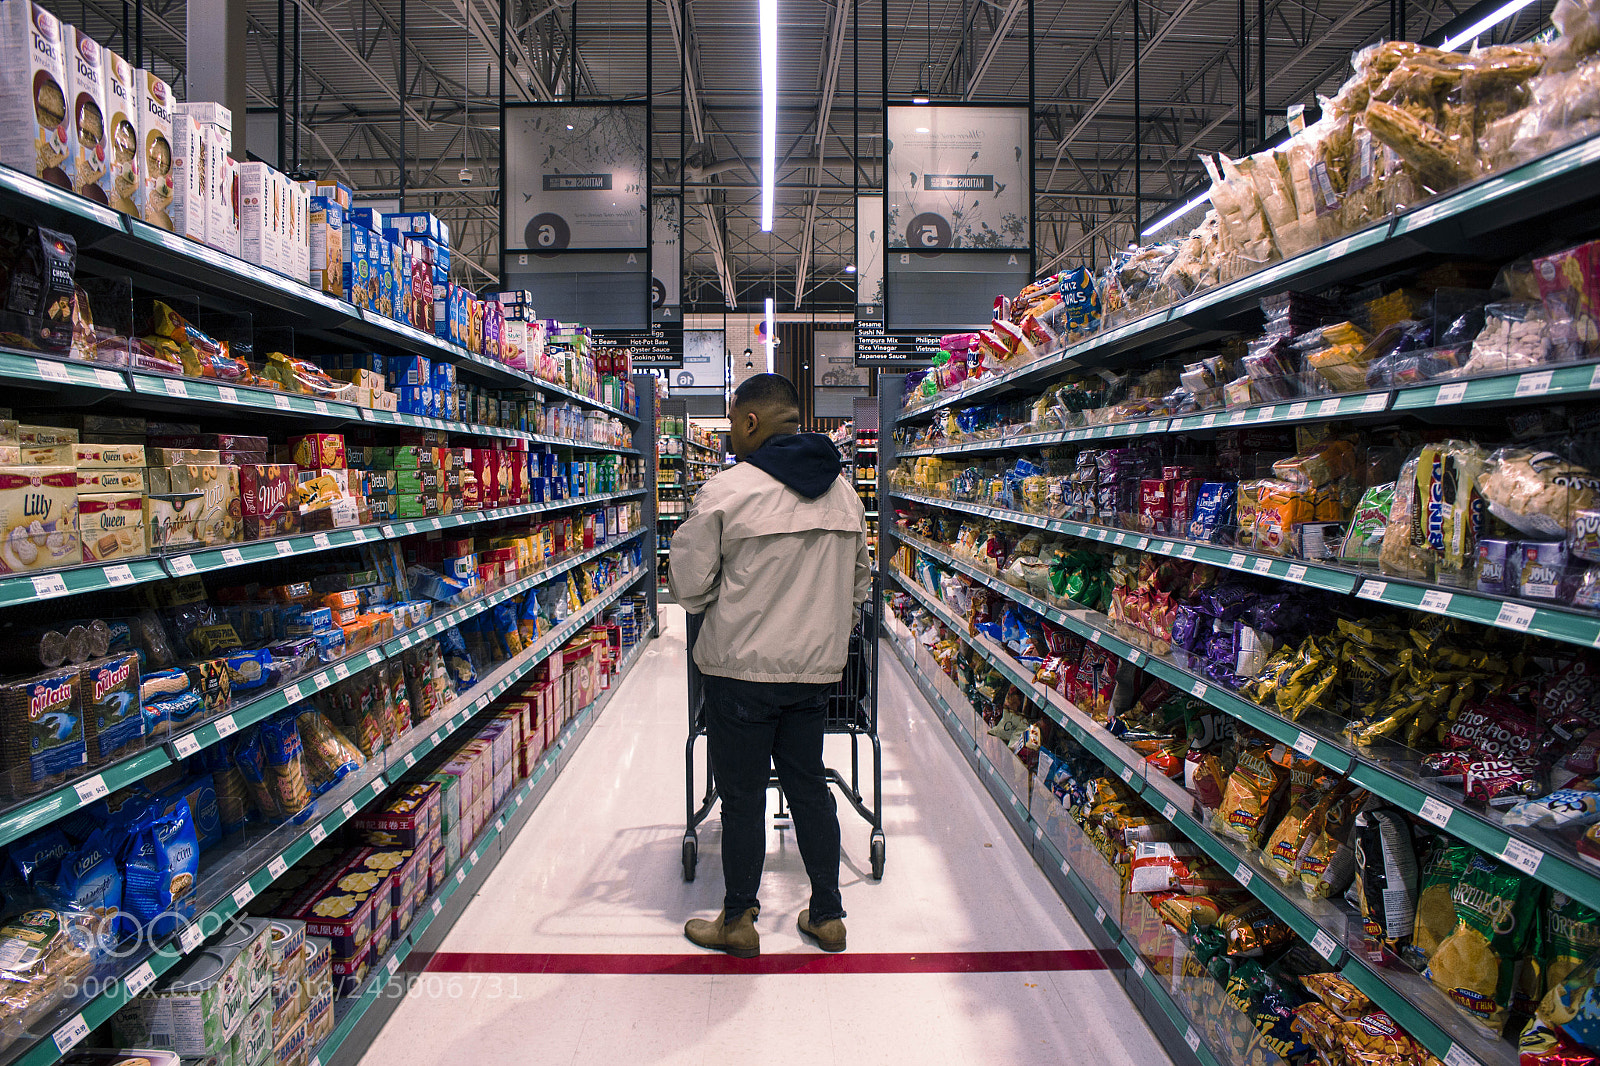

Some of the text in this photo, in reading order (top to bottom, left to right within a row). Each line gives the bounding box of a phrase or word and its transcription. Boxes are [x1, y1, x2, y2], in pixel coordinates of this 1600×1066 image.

[858, 328, 875, 336] Sushi
[858, 337, 886, 345] Tempura
[915, 337, 942, 345] Philippin
[872, 344, 898, 352] Vinegar
[630, 346, 651, 354] Oyster
[858, 353, 888, 361] Japanese
[102, 450, 121, 463] Queen
[101, 475, 119, 487] Queen
[24, 494, 52, 519] Lilly
[1428, 462, 1445, 550] BINGO
[100, 513, 126, 532] Queen
[1530, 567, 1556, 582] JOLLY
[95, 664, 129, 700] Milata
[31, 684, 71, 718] Milata
[1470, 757, 1541, 771] choco
[1467, 767, 1538, 782] knots
[283, 930, 304, 960] BROAS
[308, 947, 329, 978] BROAS
[309, 991, 331, 1023] BROAS
[280, 1026, 305, 1061] BROAS
